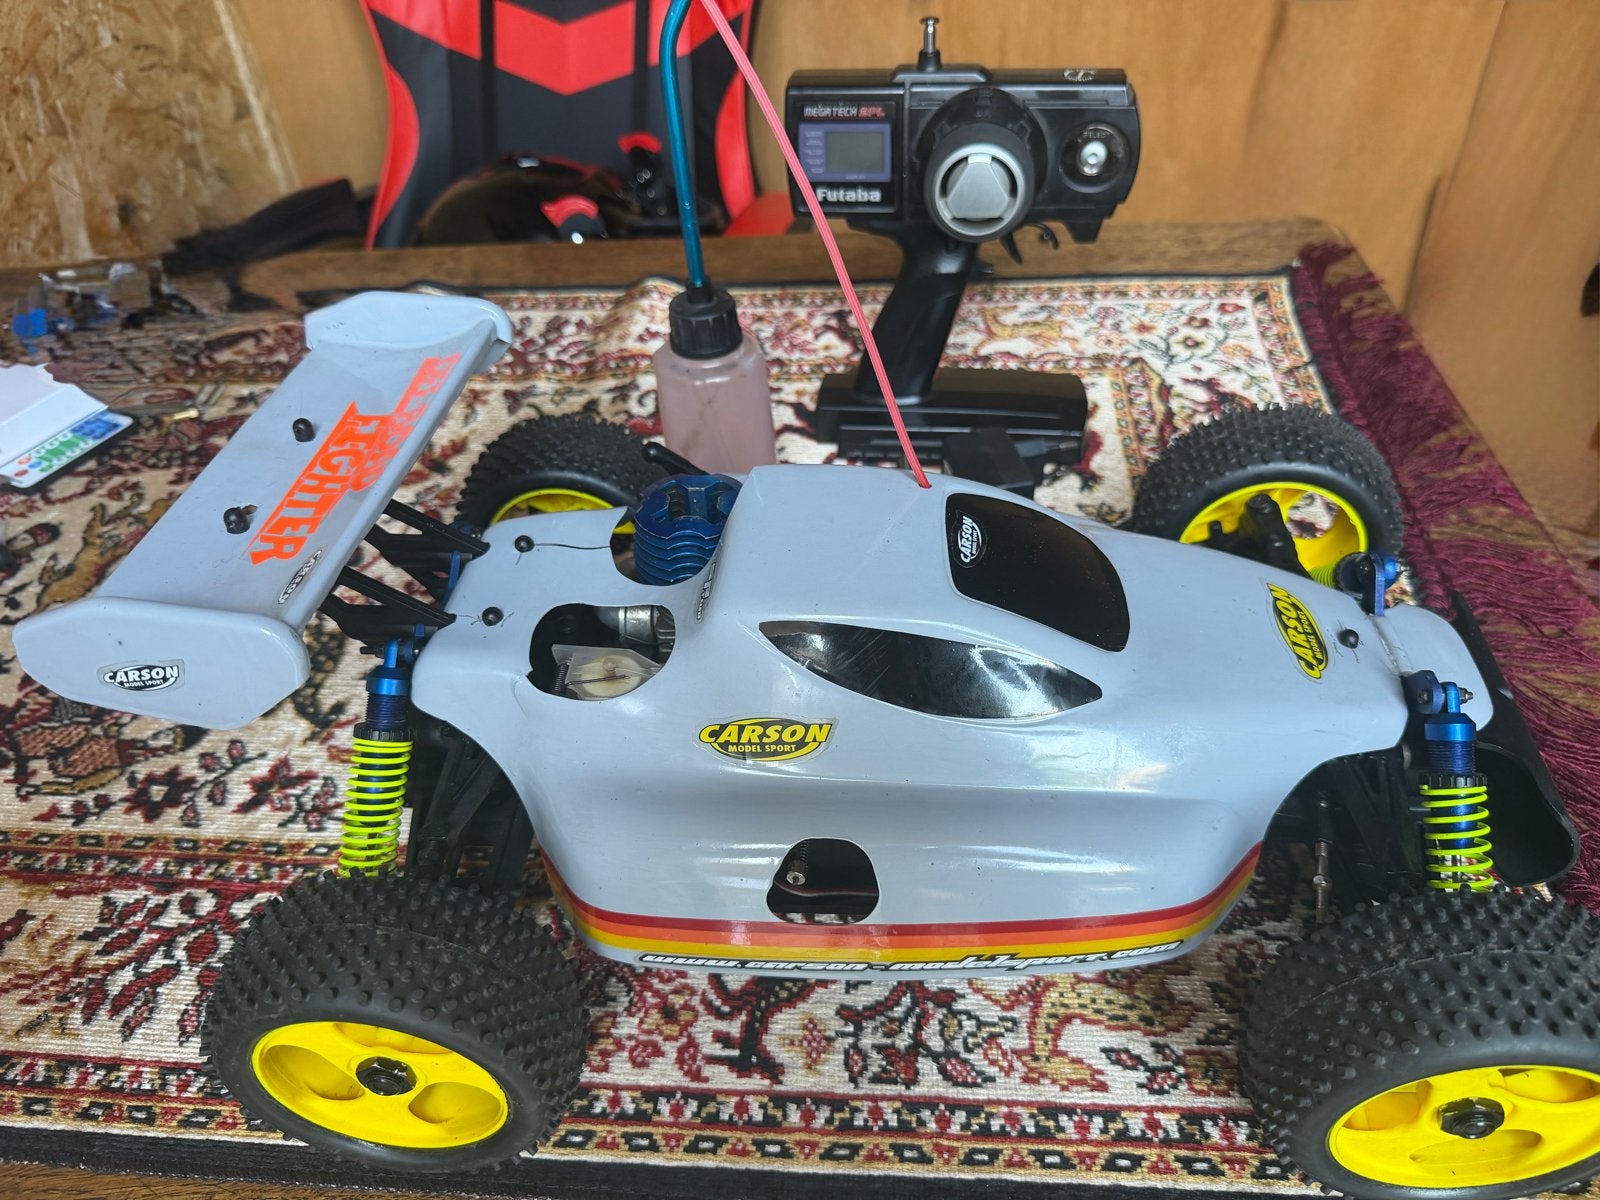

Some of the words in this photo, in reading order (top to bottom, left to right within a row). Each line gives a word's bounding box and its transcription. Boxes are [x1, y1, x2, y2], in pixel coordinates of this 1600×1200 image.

[804, 105, 857, 116] MEGATECH
[817, 187, 881, 202] Futaba
[250, 412, 392, 565] FIGHTER
[961, 515, 973, 563] CARSON
[1267, 583, 1321, 679] CARSON
[104, 666, 178, 683] CARSON
[700, 724, 832, 743] CARSON
[728, 745, 762, 753] MODEL
[765, 744, 797, 752] SPORT
